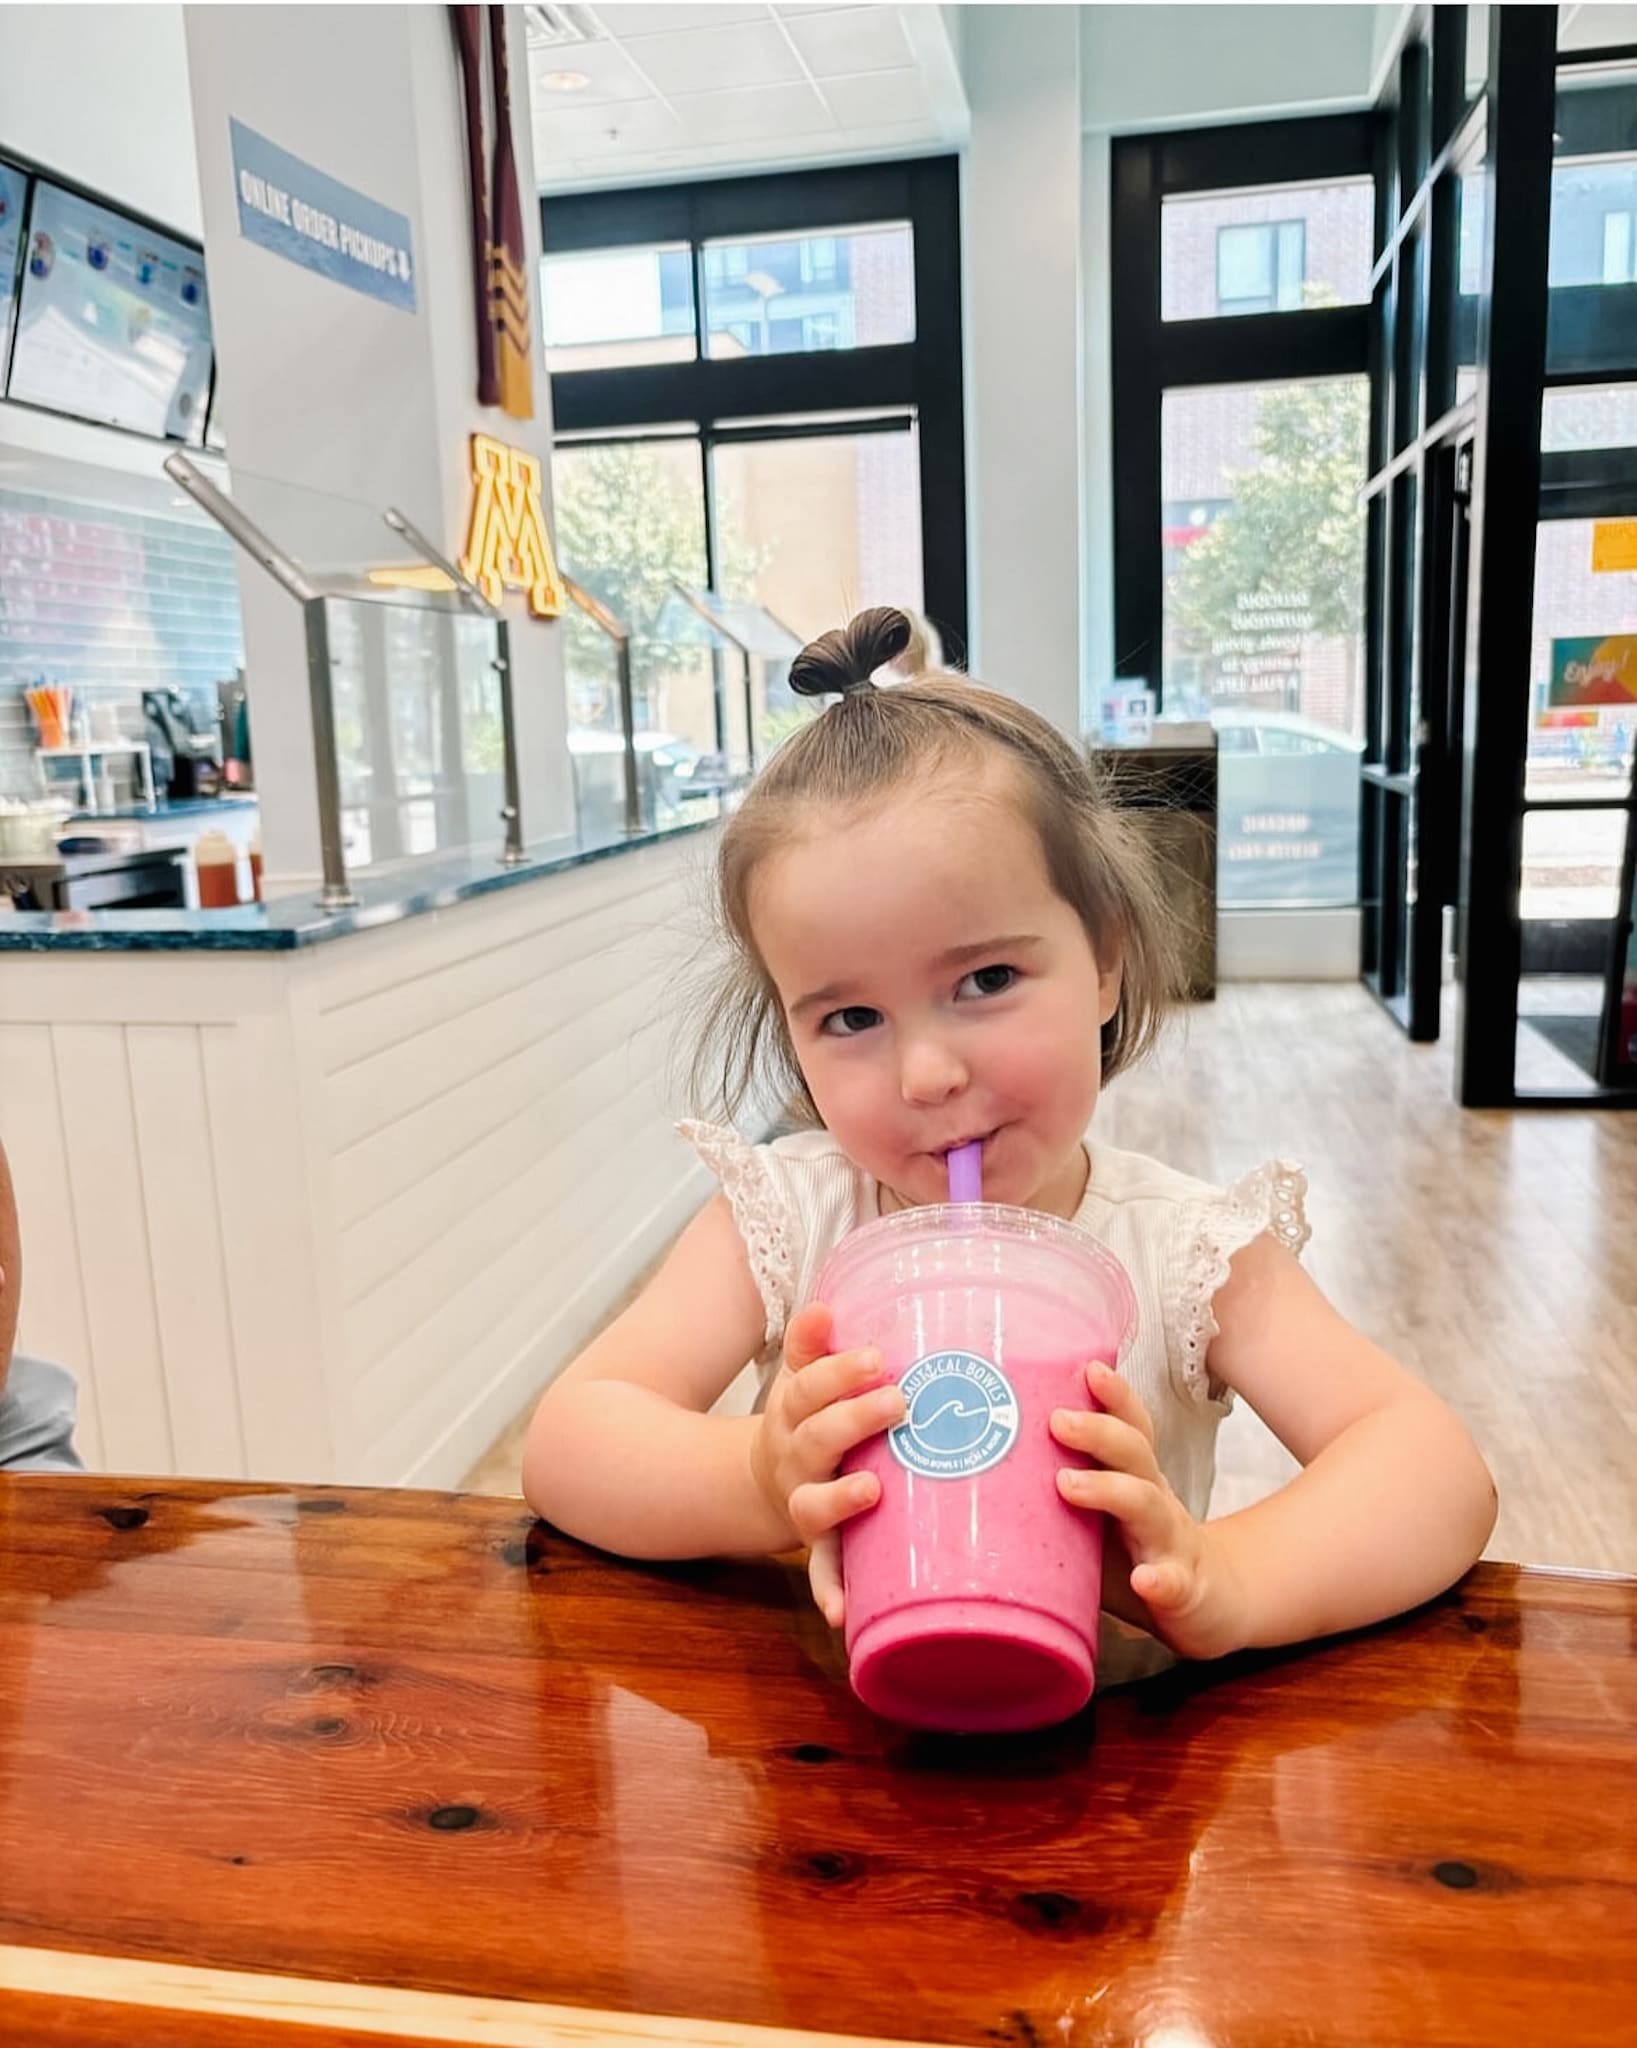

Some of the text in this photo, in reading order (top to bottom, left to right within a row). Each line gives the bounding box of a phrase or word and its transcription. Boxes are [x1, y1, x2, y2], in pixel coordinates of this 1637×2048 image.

[240, 169, 398, 276] ONLINE ORDER PICKUPS
[903, 1357, 1007, 1405] AUTICAL BOWLS
